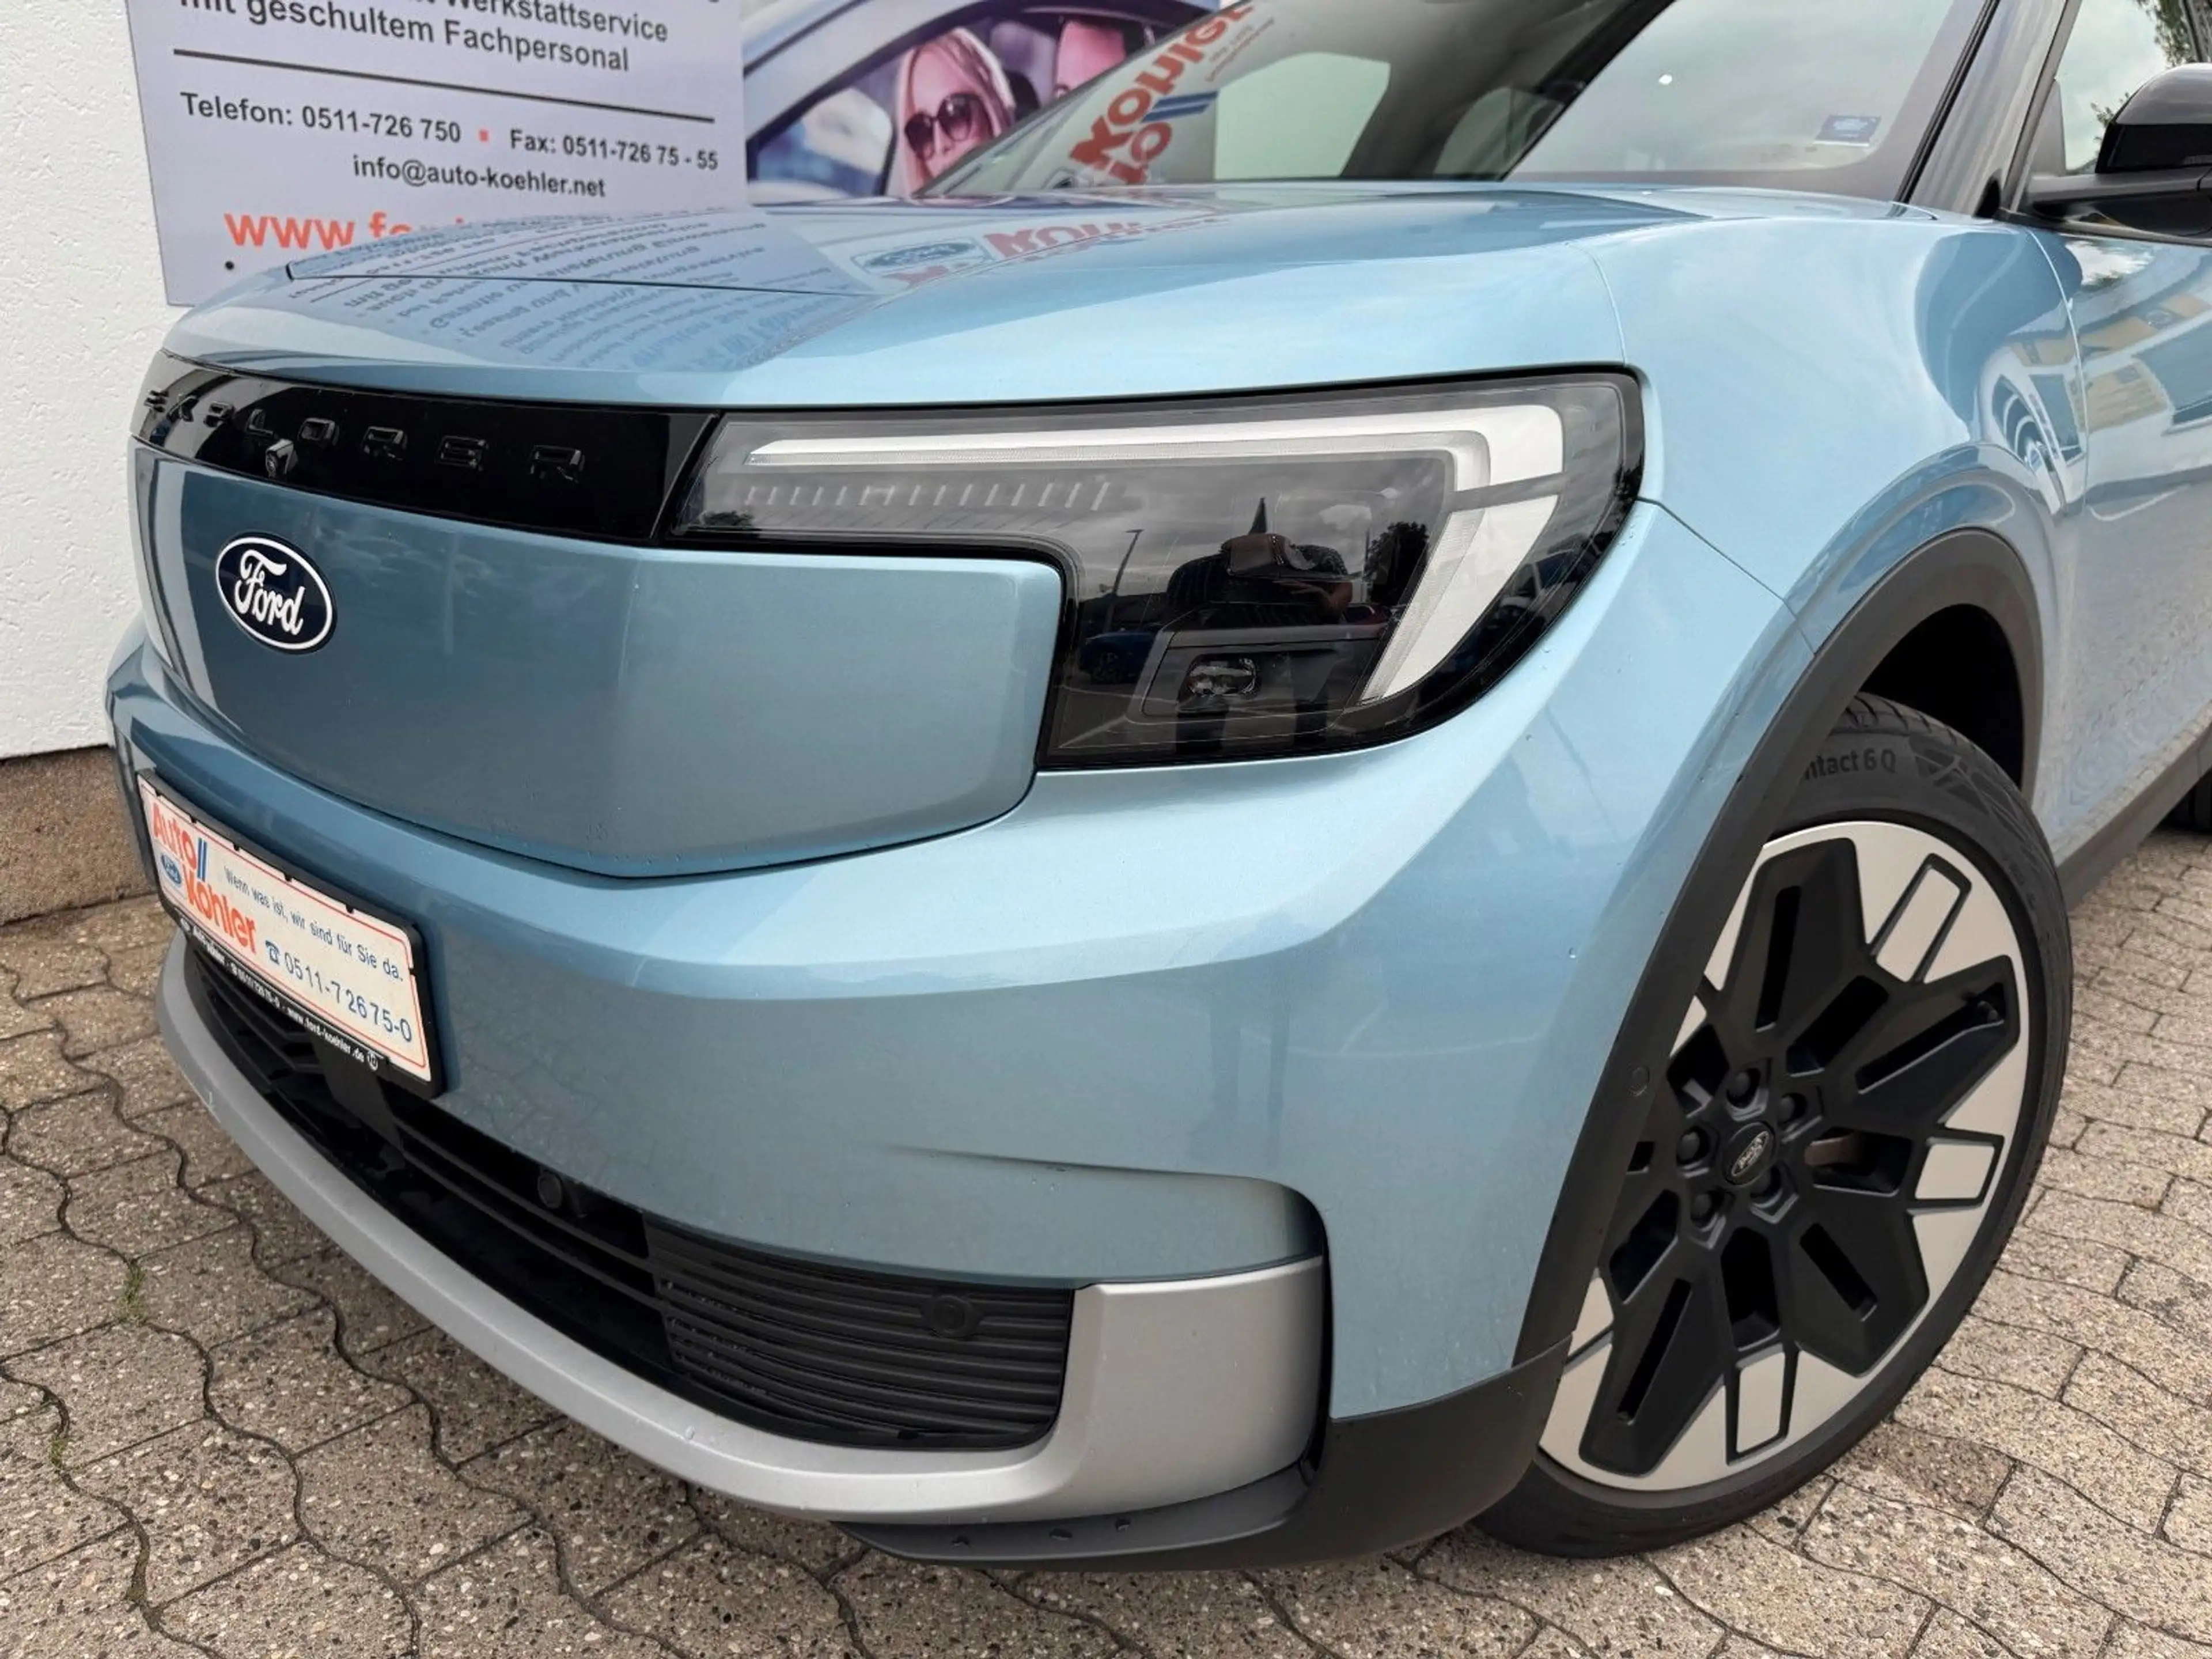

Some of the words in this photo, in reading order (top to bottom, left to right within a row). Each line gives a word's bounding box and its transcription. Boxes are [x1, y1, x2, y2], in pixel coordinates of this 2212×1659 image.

[247, 0, 434, 43] geschultem
[445, 18, 630, 72] Fachpersonal
[180, 92, 292, 126] Telefon:
[302, 105, 412, 138] 0511-726
[421, 119, 461, 143] 750
[510, 128, 556, 154] Fax:
[563, 135, 652, 164] 0511-726
[657, 145, 679, 167] 75
[696, 149, 719, 171] 55
[353, 155, 606, 198] info@auto-koehler.net
[233, 547, 307, 637] Ford
[152, 802, 197, 870] Auto
[224, 865, 250, 896] Wenn
[251, 887, 270, 908] was
[290, 911, 306, 929] wir
[309, 920, 333, 945] sind
[336, 933, 353, 957] für
[356, 944, 377, 969] Sie
[382, 958, 404, 982] da.
